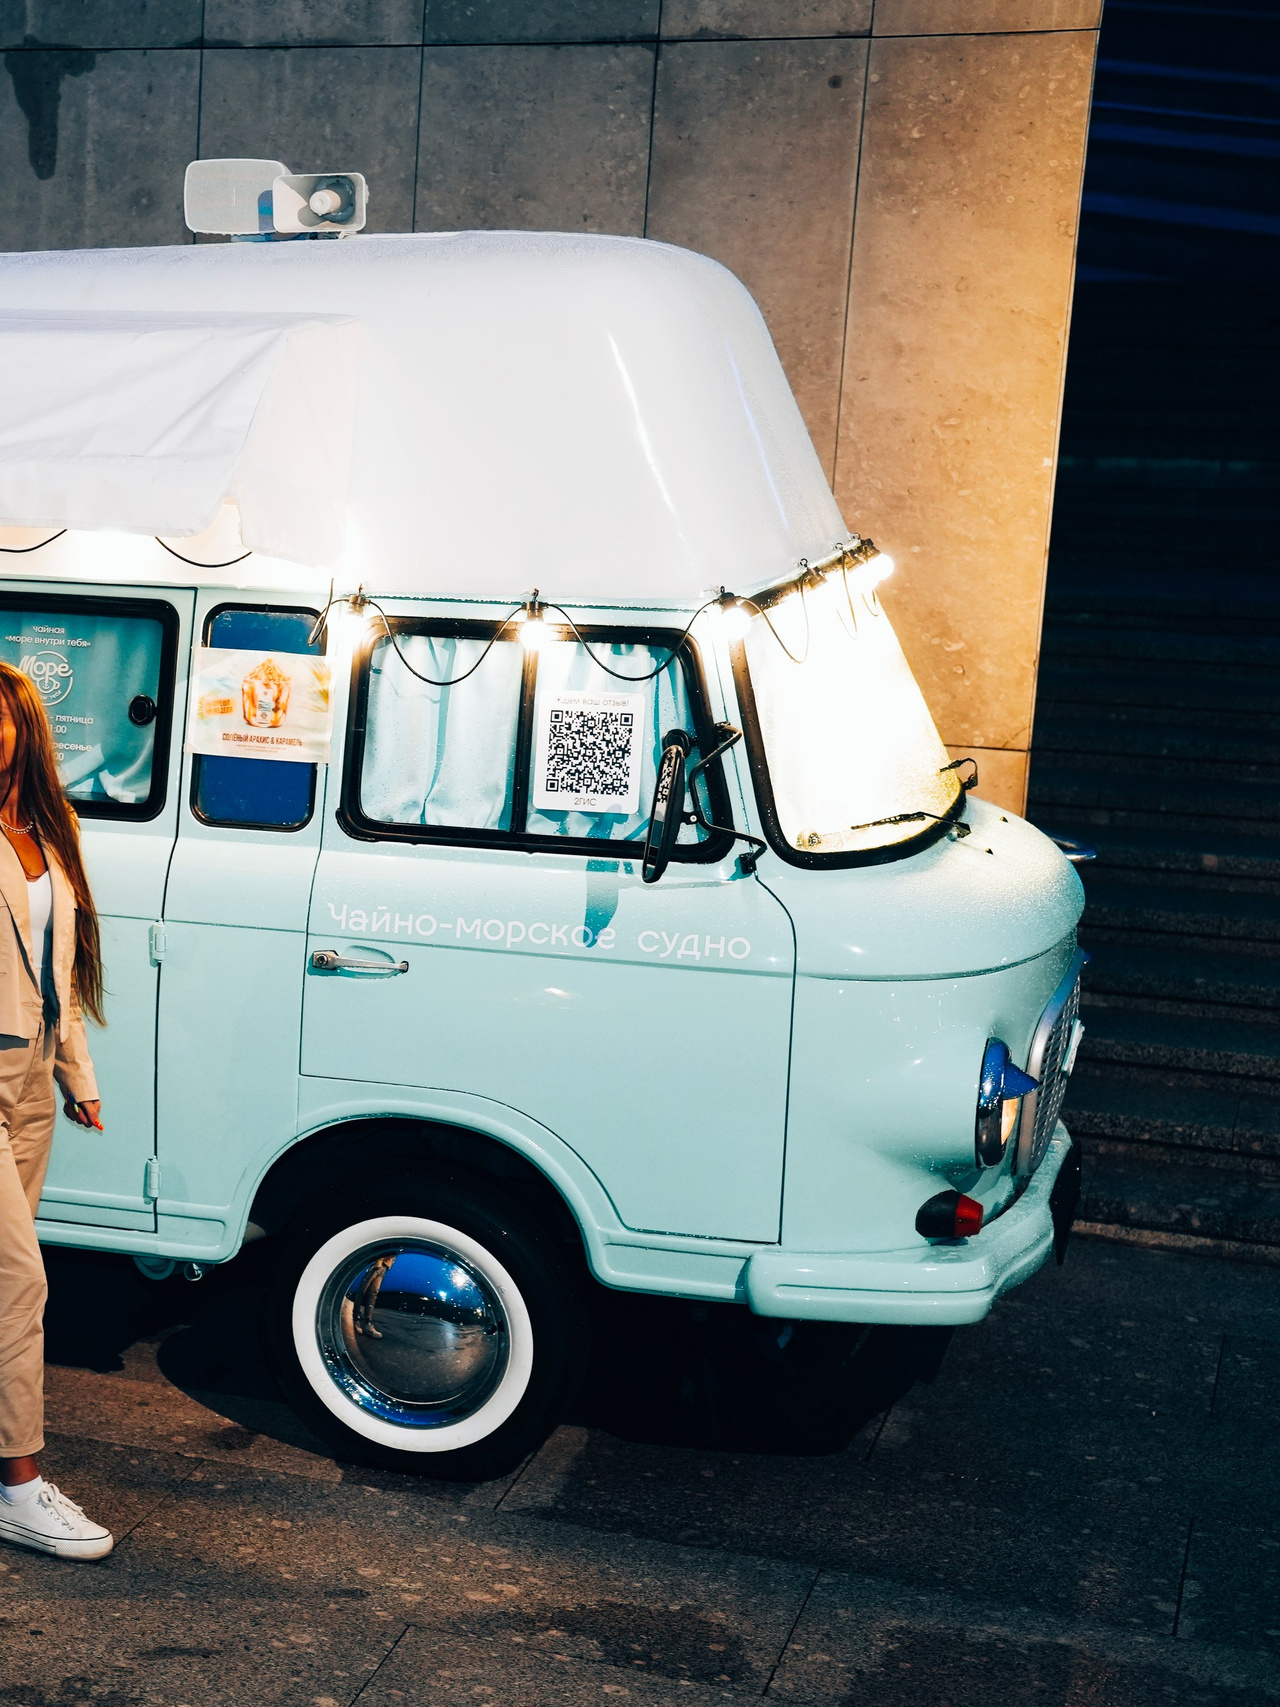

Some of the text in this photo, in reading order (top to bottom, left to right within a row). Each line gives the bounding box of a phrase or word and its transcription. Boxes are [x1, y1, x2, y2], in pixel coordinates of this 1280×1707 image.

[32, 624, 65, 634] чайная
[34, 637, 65, 647] внутри
[19, 655, 73, 687] Море
[582, 698, 601, 706] ваш
[602, 699, 630, 707] отзыв!
[55, 715, 94, 725] пятница
[49, 724, 67, 734] 1:00
[249, 735, 270, 744] АРАХИС
[276, 737, 303, 747] КАРАМЕЛЬ
[573, 797, 597, 806] 2ГИС
[326, 902, 751, 961] Чайно-морское судно
